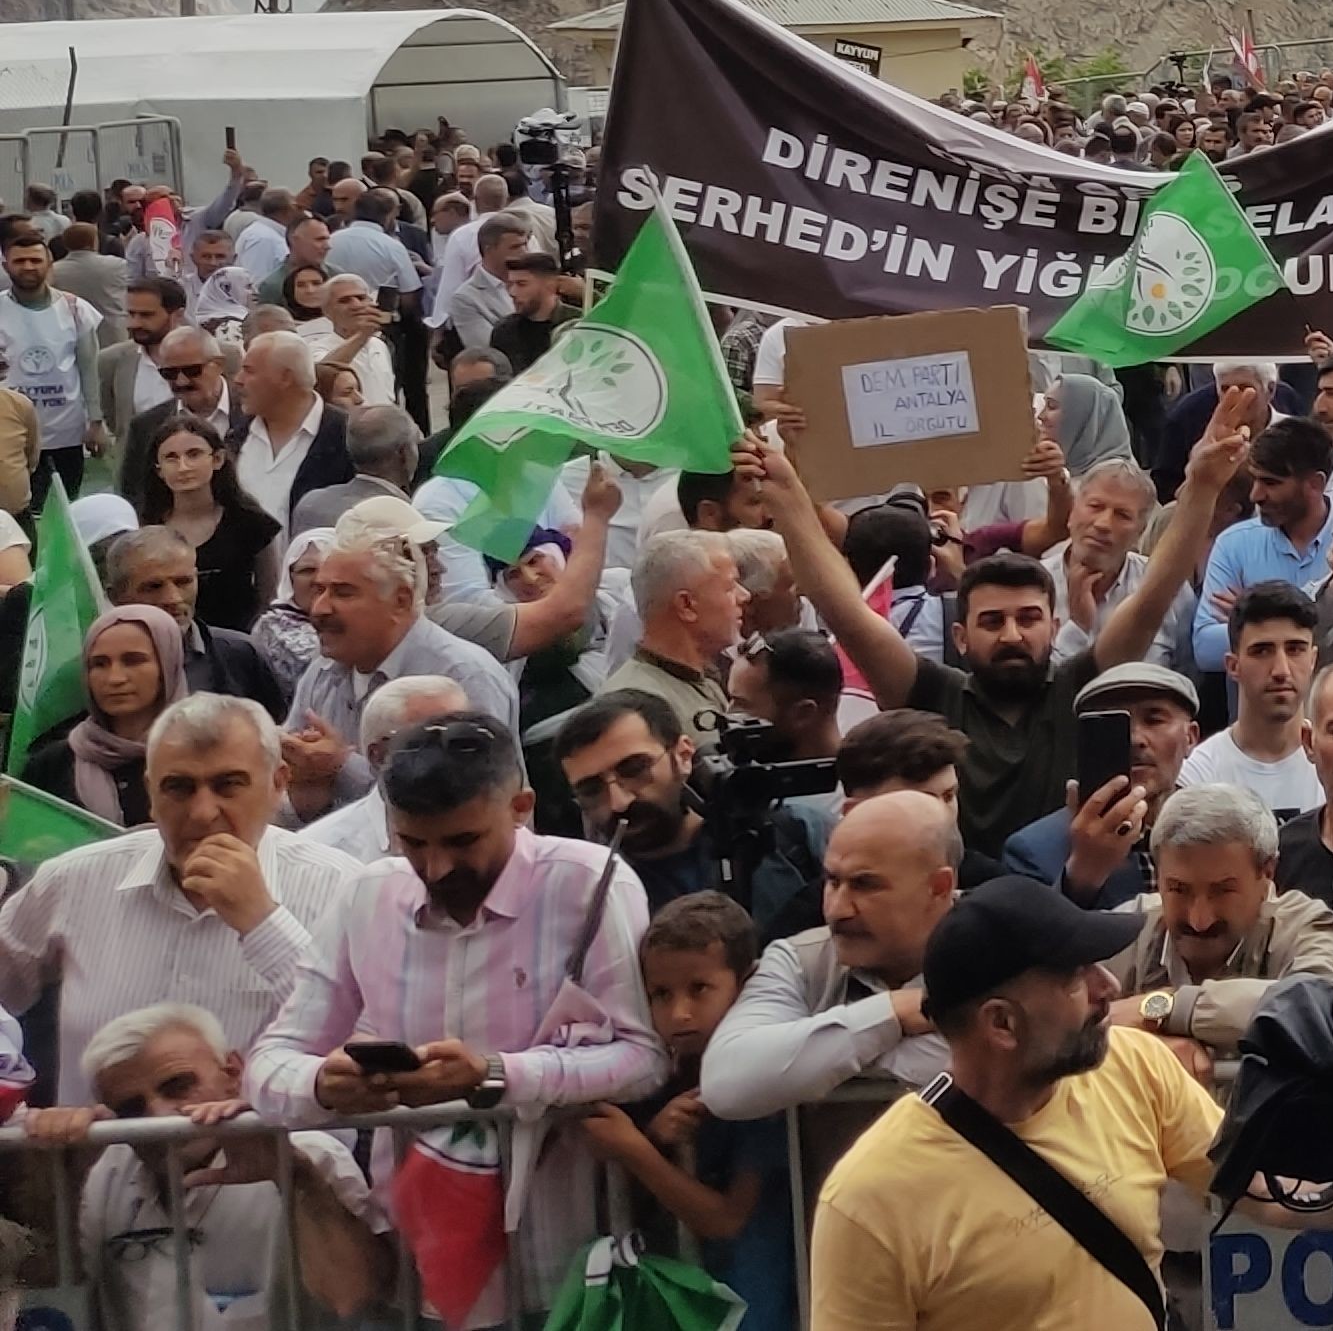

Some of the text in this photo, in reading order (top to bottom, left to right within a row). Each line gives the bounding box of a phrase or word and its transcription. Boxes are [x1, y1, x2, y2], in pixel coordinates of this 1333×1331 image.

[836, 42, 880, 61] KAYYUM
[762, 127, 1062, 230] DİRENİŞE
[617, 168, 955, 283] SERHED'İN
[860, 368, 907, 394] DEM
[894, 389, 968, 411] ANTALYA
